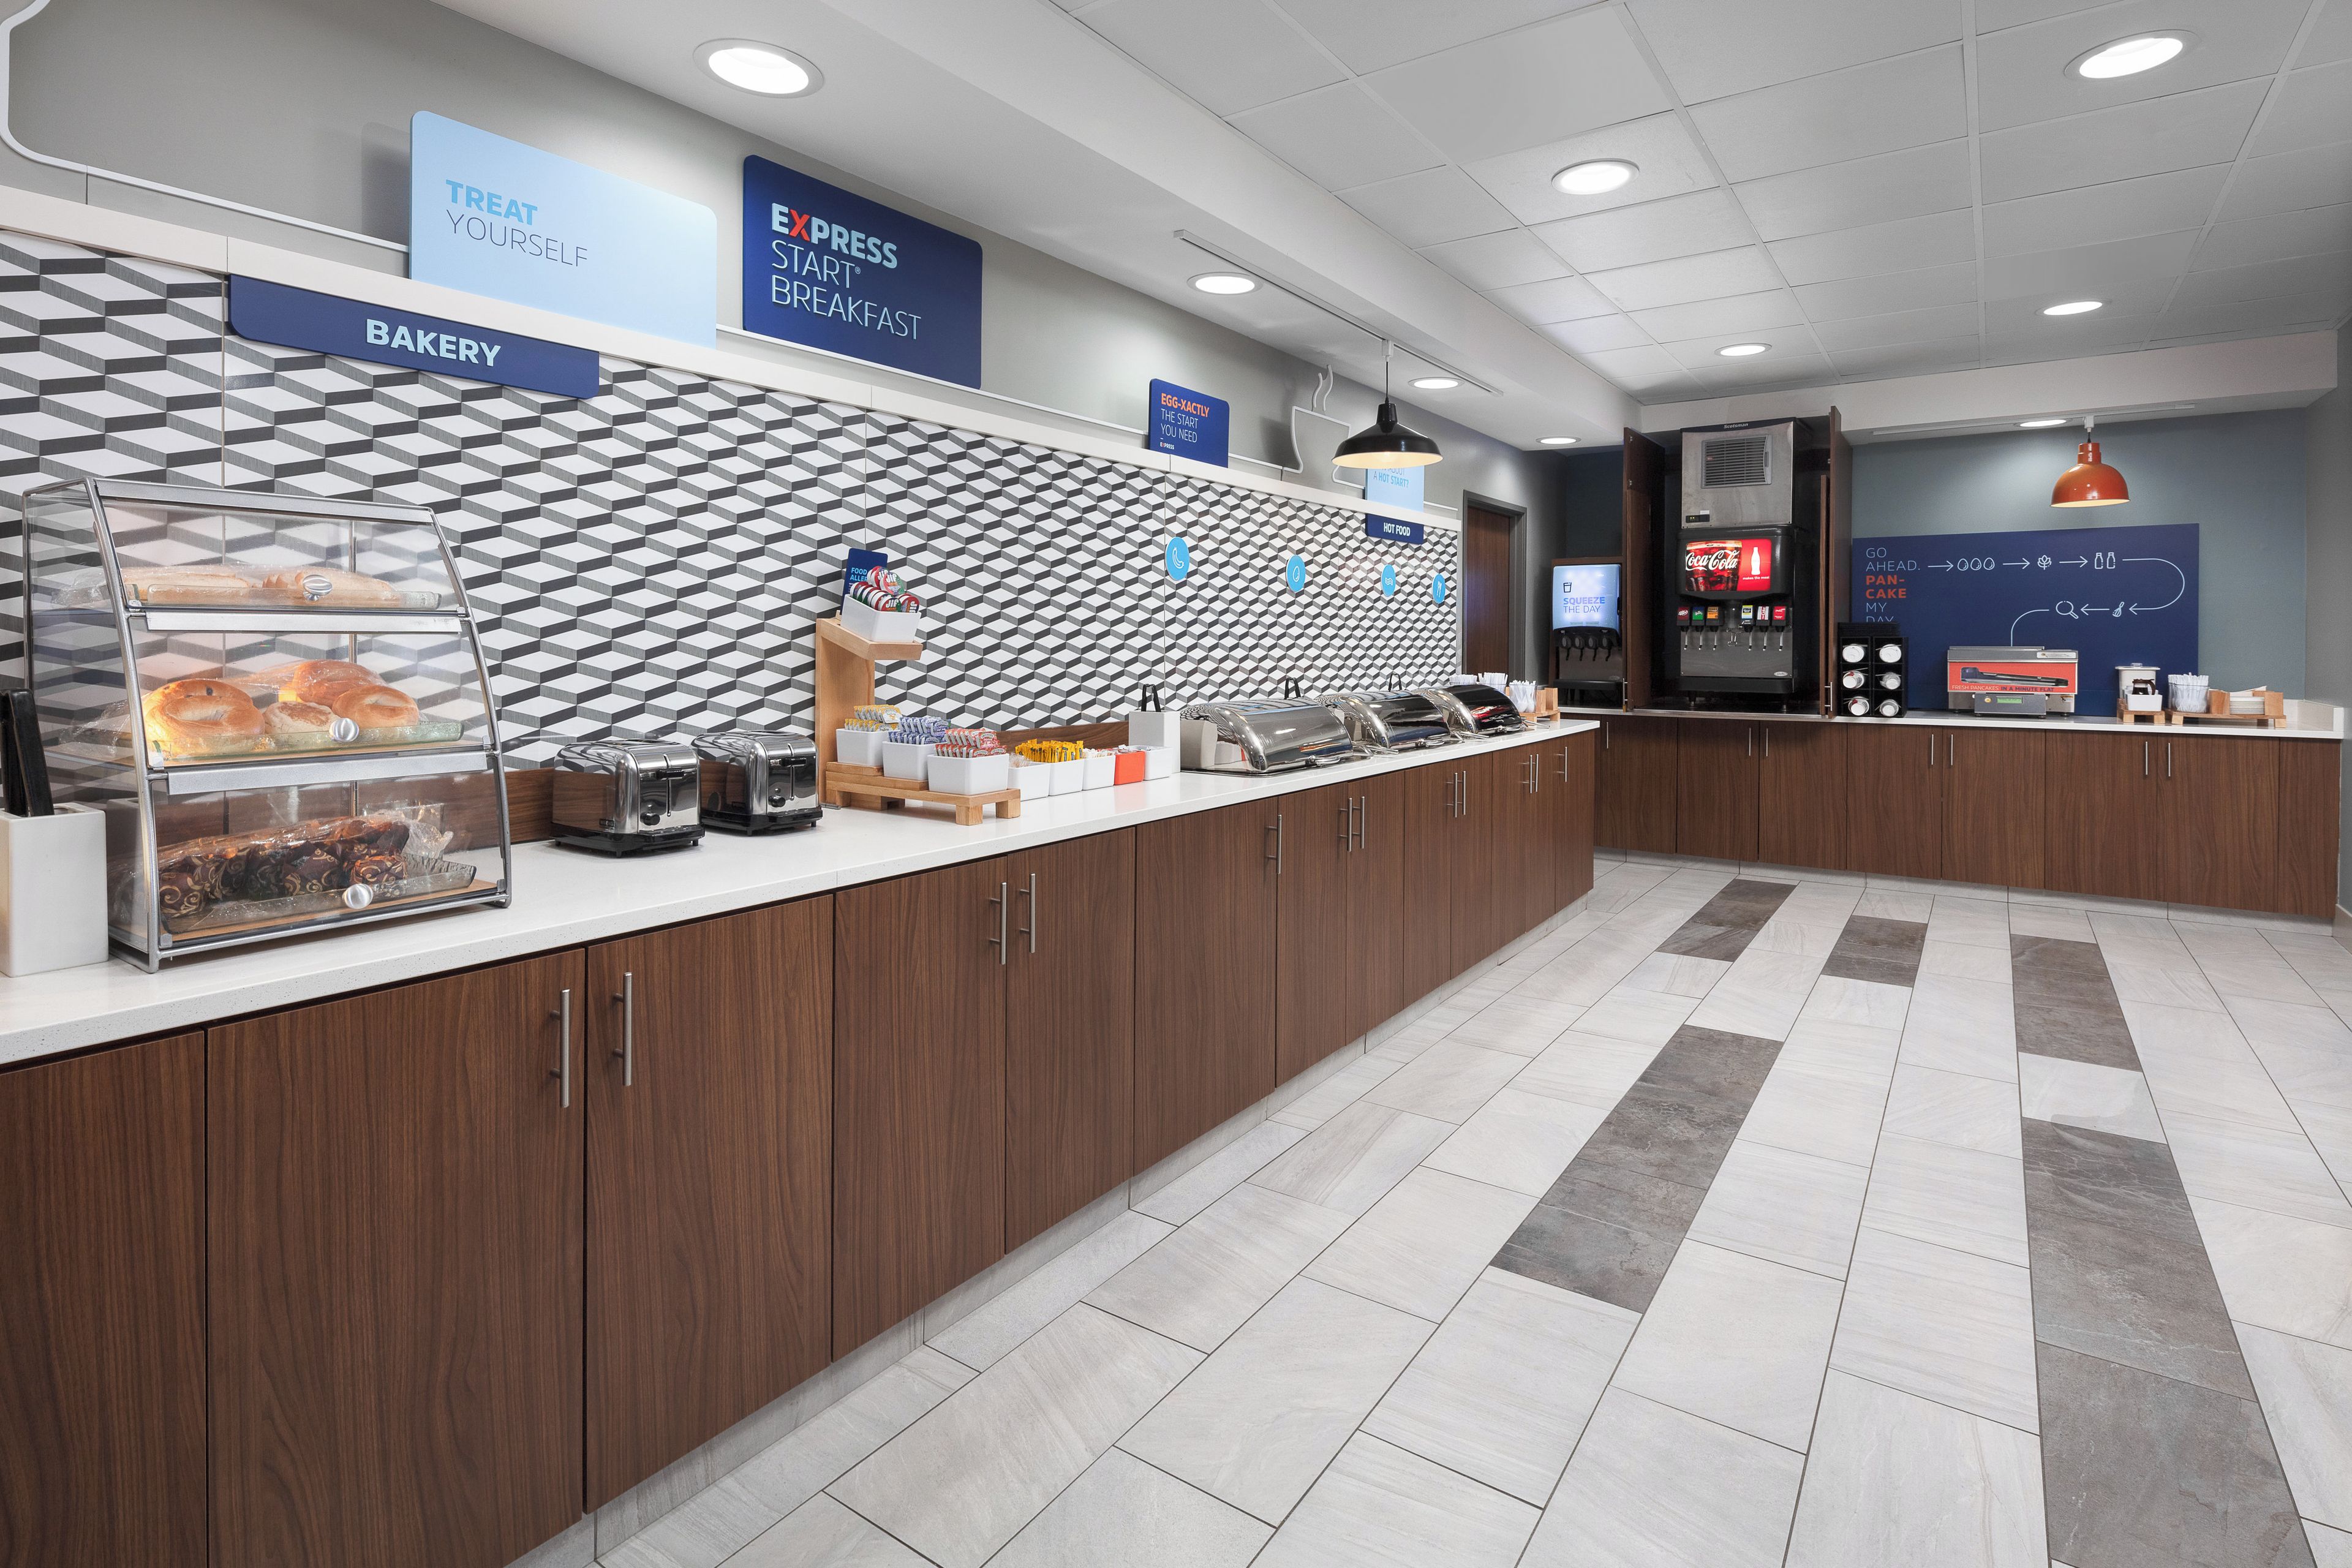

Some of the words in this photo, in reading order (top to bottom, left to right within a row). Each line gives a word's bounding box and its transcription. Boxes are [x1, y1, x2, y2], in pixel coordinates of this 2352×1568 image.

[445, 179, 538, 226] TREAT
[446, 209, 588, 267] YOURSELF
[772, 203, 898, 269] EXPRESS
[772, 274, 922, 340] BREAKFAST
[366, 318, 502, 367] BAKERY
[1161, 393, 1210, 418] EGG-XACTLY
[1161, 408, 1175, 423] THE
[1177, 413, 1199, 429] START
[1161, 423, 1177, 437] YOU
[1178, 428, 1198, 443] NEED
[1373, 470, 1378, 480] A
[1379, 472, 1390, 483] HOT
[1390, 475, 1409, 488] START?
[1383, 522, 1395, 534] HOT
[1396, 525, 1411, 537] FOOD
[1686, 549, 1740, 571] Coca-Cola
[1866, 547, 1887, 558] GO
[1866, 560, 1921, 571] AHEAD.
[1866, 575, 1905, 585] PAN-
[1563, 597, 1605, 605] SQUEEZE
[1866, 588, 1907, 598] CAKE
[1866, 602, 1887, 612] MY
